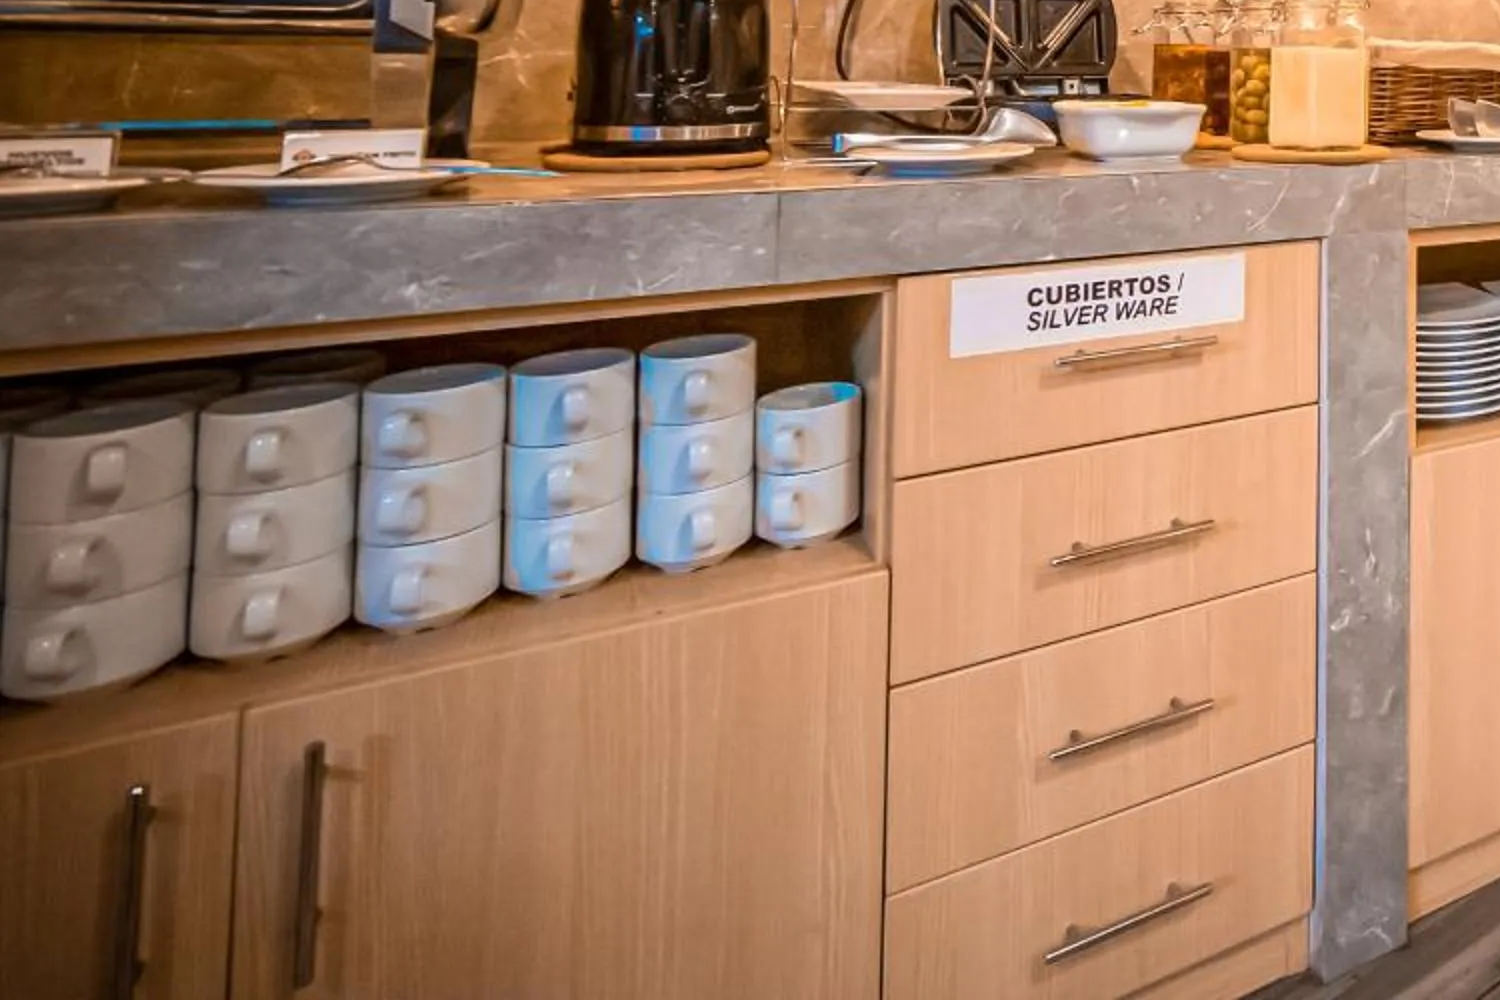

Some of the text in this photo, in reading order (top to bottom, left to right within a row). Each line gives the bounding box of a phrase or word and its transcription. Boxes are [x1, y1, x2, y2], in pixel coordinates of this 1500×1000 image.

[1027, 272, 1185, 307] CUBIERTOS /
[1027, 295, 1180, 332] SILVER WARE
